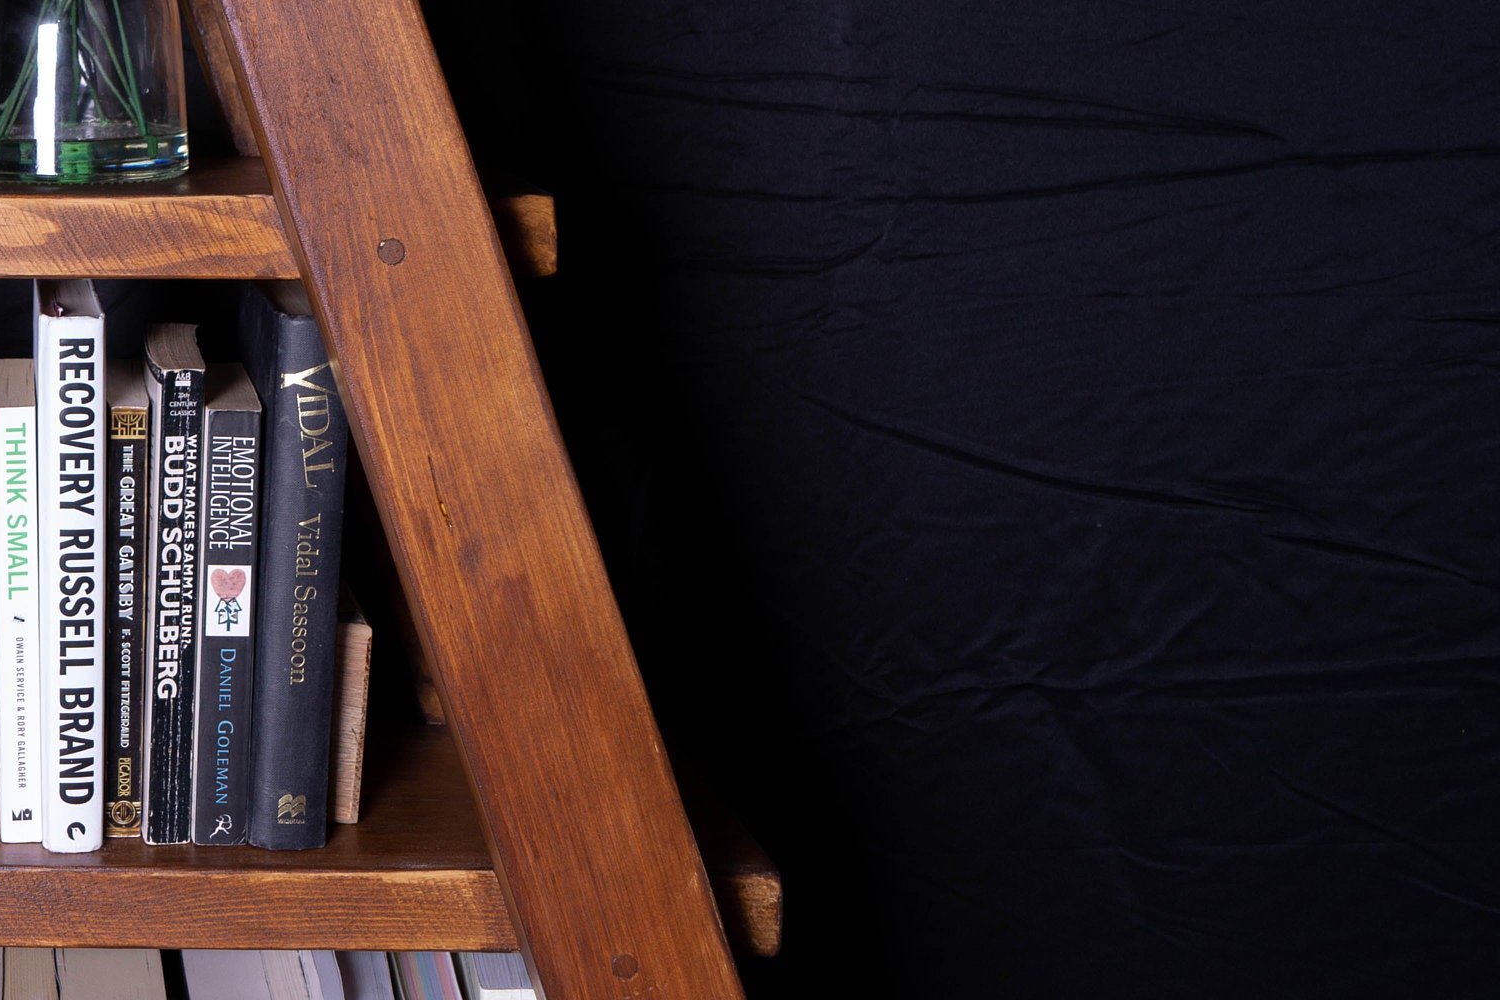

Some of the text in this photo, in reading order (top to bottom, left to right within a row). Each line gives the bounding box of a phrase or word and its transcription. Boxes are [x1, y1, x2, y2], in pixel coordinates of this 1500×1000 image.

[58, 339, 96, 516] RECOVERY
[169, 400, 198, 408] CENTURY
[170, 409, 197, 417] CLASSICS
[185, 434, 198, 479] WHAT
[281, 360, 336, 488] VIDAL
[6, 422, 29, 601] THINK SMALL
[118, 444, 135, 621] THE GREAT GATSBY
[183, 487, 197, 539] MAKES
[209, 435, 233, 550] INTELLIGENCE
[229, 435, 256, 550] EMOTIONAL
[157, 434, 185, 701] BUDD SCHULBERG
[181, 542, 196, 600] SAMMY
[289, 513, 322, 686] Vidal Sassoon
[16, 637, 24, 664] OWAIN
[16, 667, 25, 702] SERVICE
[58, 529, 96, 806] RUSSELL BRAND
[120, 628, 131, 748] F. SCOTT FITZGERALD
[17, 715, 26, 738] RORY
[17, 741, 27, 789] GALLAGHER
[118, 757, 131, 797] PICADOR
[215, 648, 237, 806] DANIEL GOLEMAN
